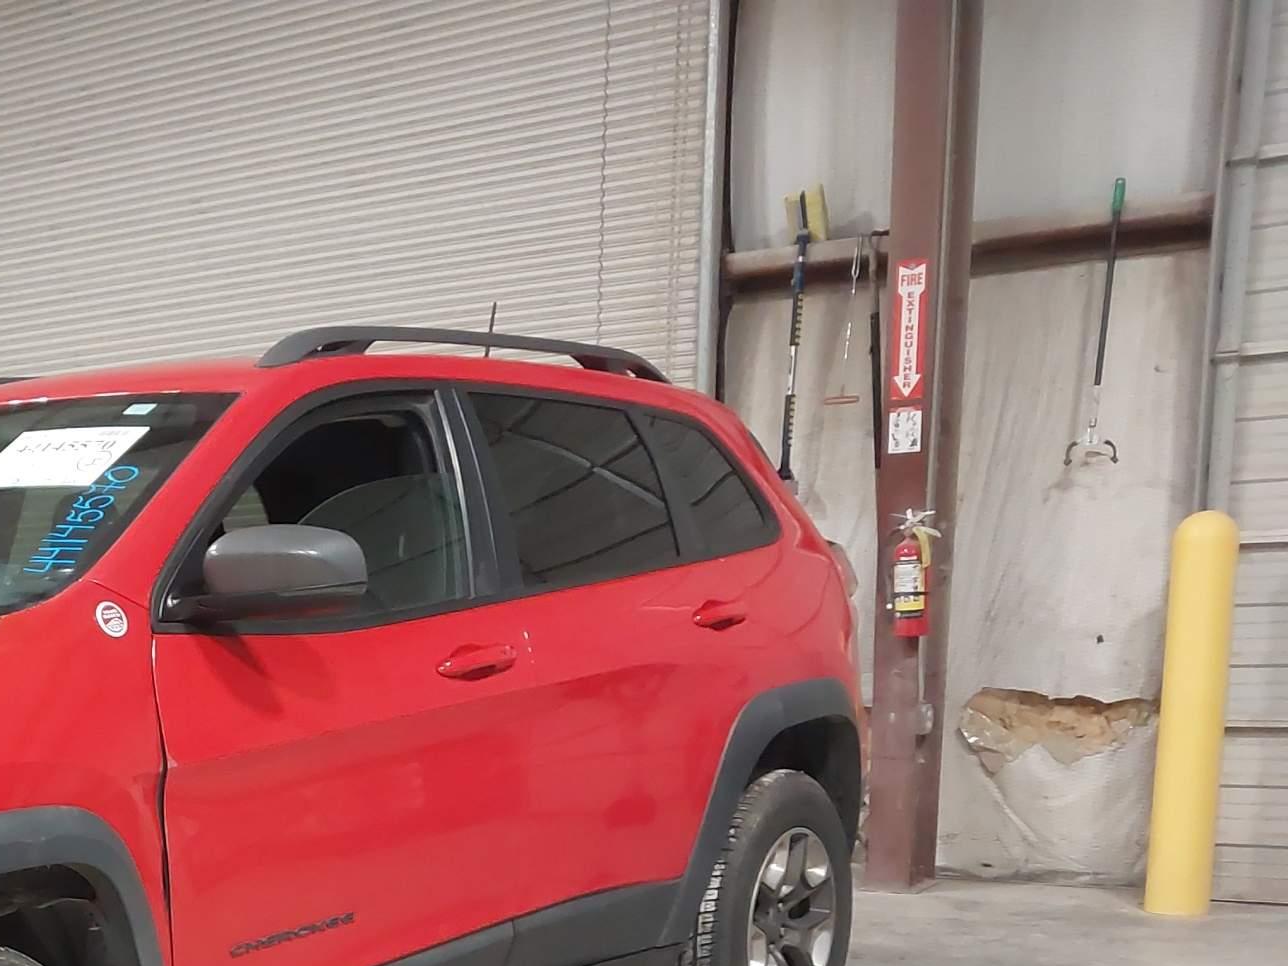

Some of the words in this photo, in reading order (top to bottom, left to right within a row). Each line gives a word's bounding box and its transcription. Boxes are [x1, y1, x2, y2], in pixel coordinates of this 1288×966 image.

[900, 272, 923, 287] FIRE
[902, 292, 915, 389] EXTINGUISHER
[24, 465, 140, 573] 44145570
[229, 911, 355, 958] CHEROKEE
